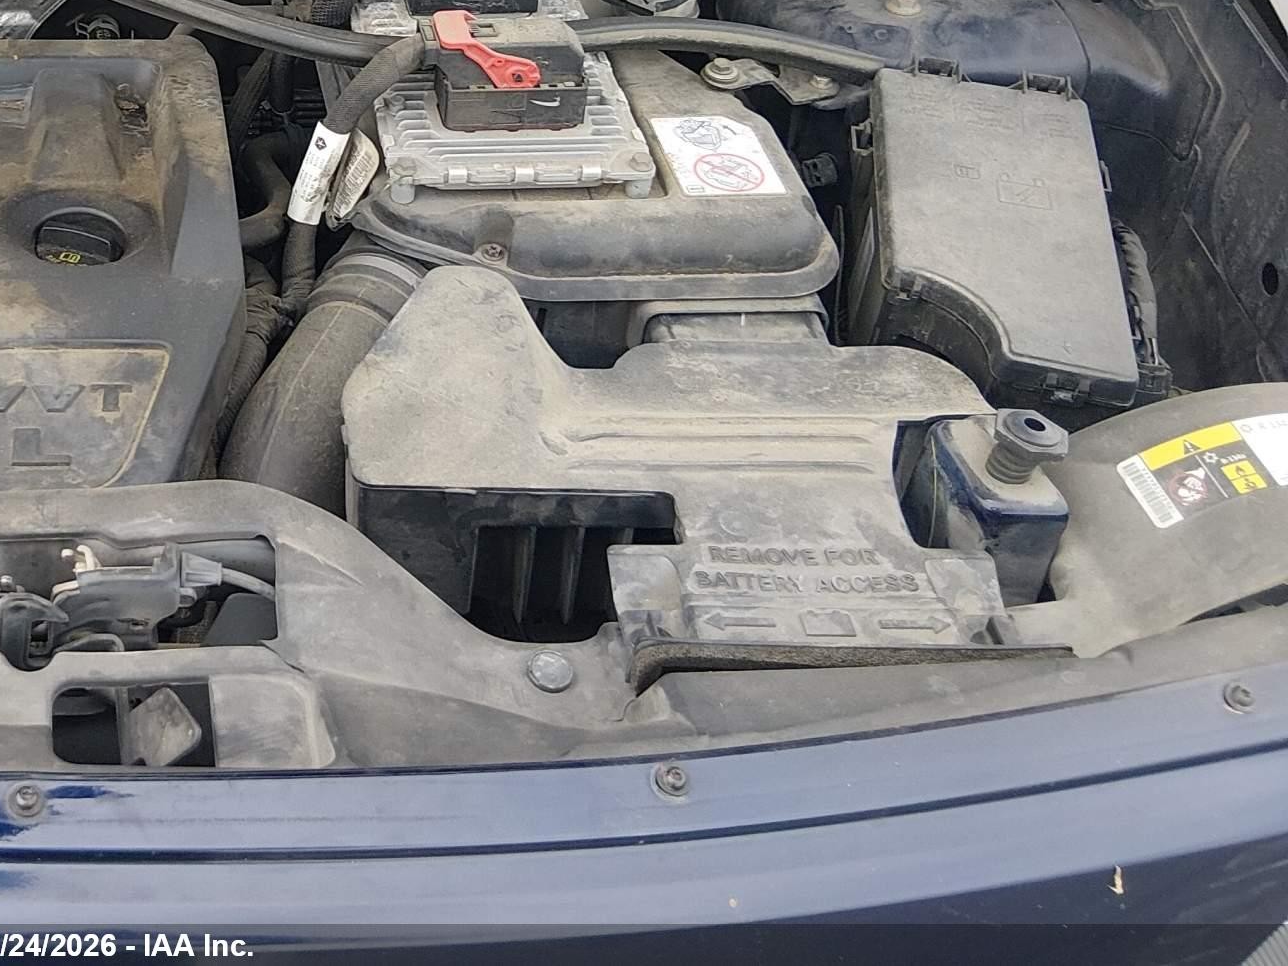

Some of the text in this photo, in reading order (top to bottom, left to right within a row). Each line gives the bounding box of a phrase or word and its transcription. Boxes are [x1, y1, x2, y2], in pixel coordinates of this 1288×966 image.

[708, 545, 881, 567] REMOVE FOR
[694, 570, 920, 595] BATTERY ACCESS
